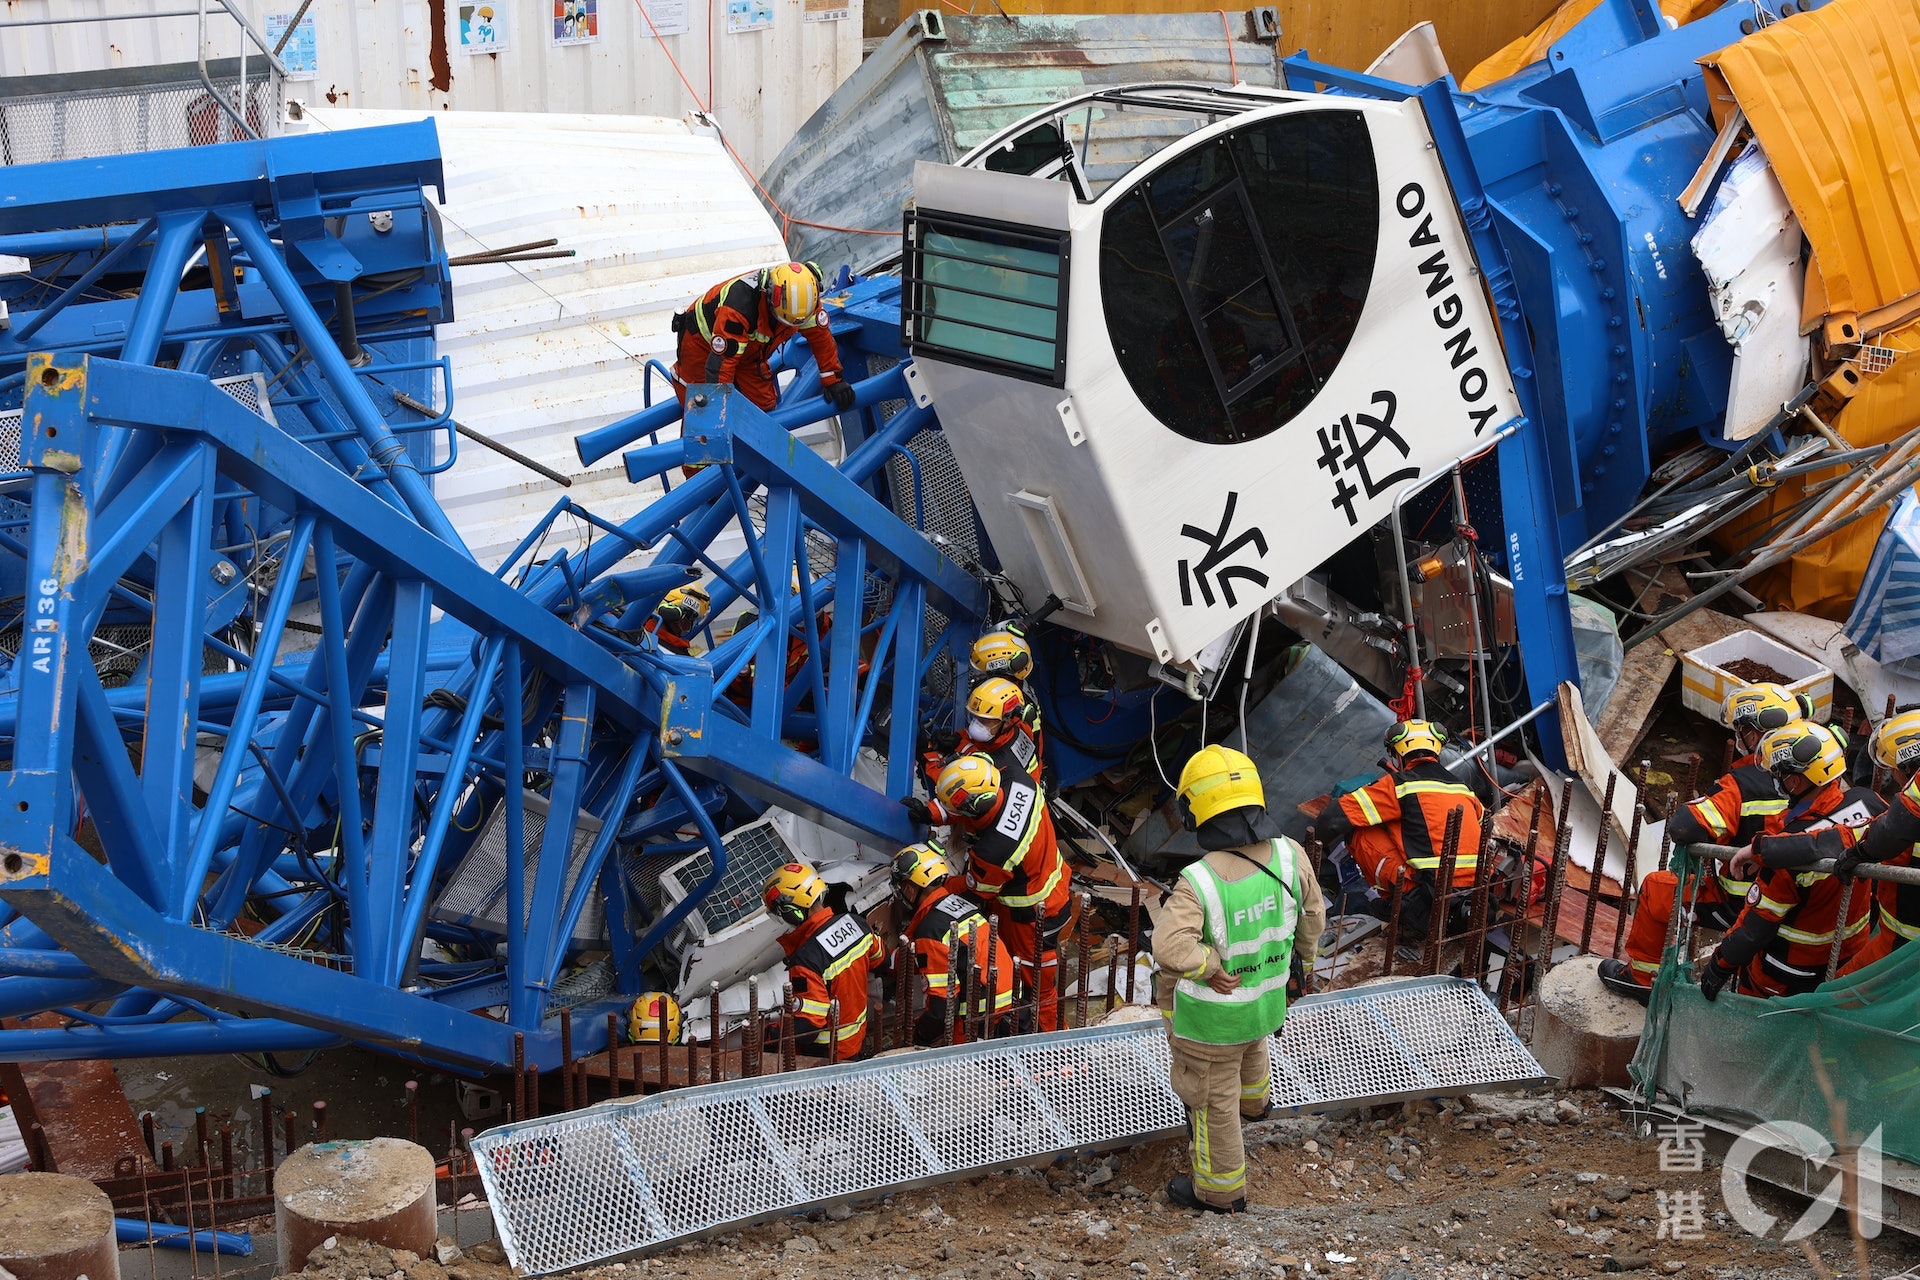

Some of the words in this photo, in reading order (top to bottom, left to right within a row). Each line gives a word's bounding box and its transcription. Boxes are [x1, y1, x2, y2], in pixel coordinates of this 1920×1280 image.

[1644, 232, 1667, 279] AR136
[1396, 182, 1498, 438] YONGMAO
[1178, 390, 1421, 609] 永茂
[1509, 532, 1524, 582] AR136
[684, 597, 699, 611] USAR
[1322, 598, 1338, 640] AR13
[32, 578, 59, 674] AR136
[988, 658, 1007, 670] HKFSD
[1735, 704, 1755, 718] HKFSD
[1016, 735, 1033, 764] USAR
[1004, 791, 1028, 831] USAR
[945, 897, 969, 912] USA
[825, 922, 857, 948] USAR
[1265, 953, 1285, 965] AFE
